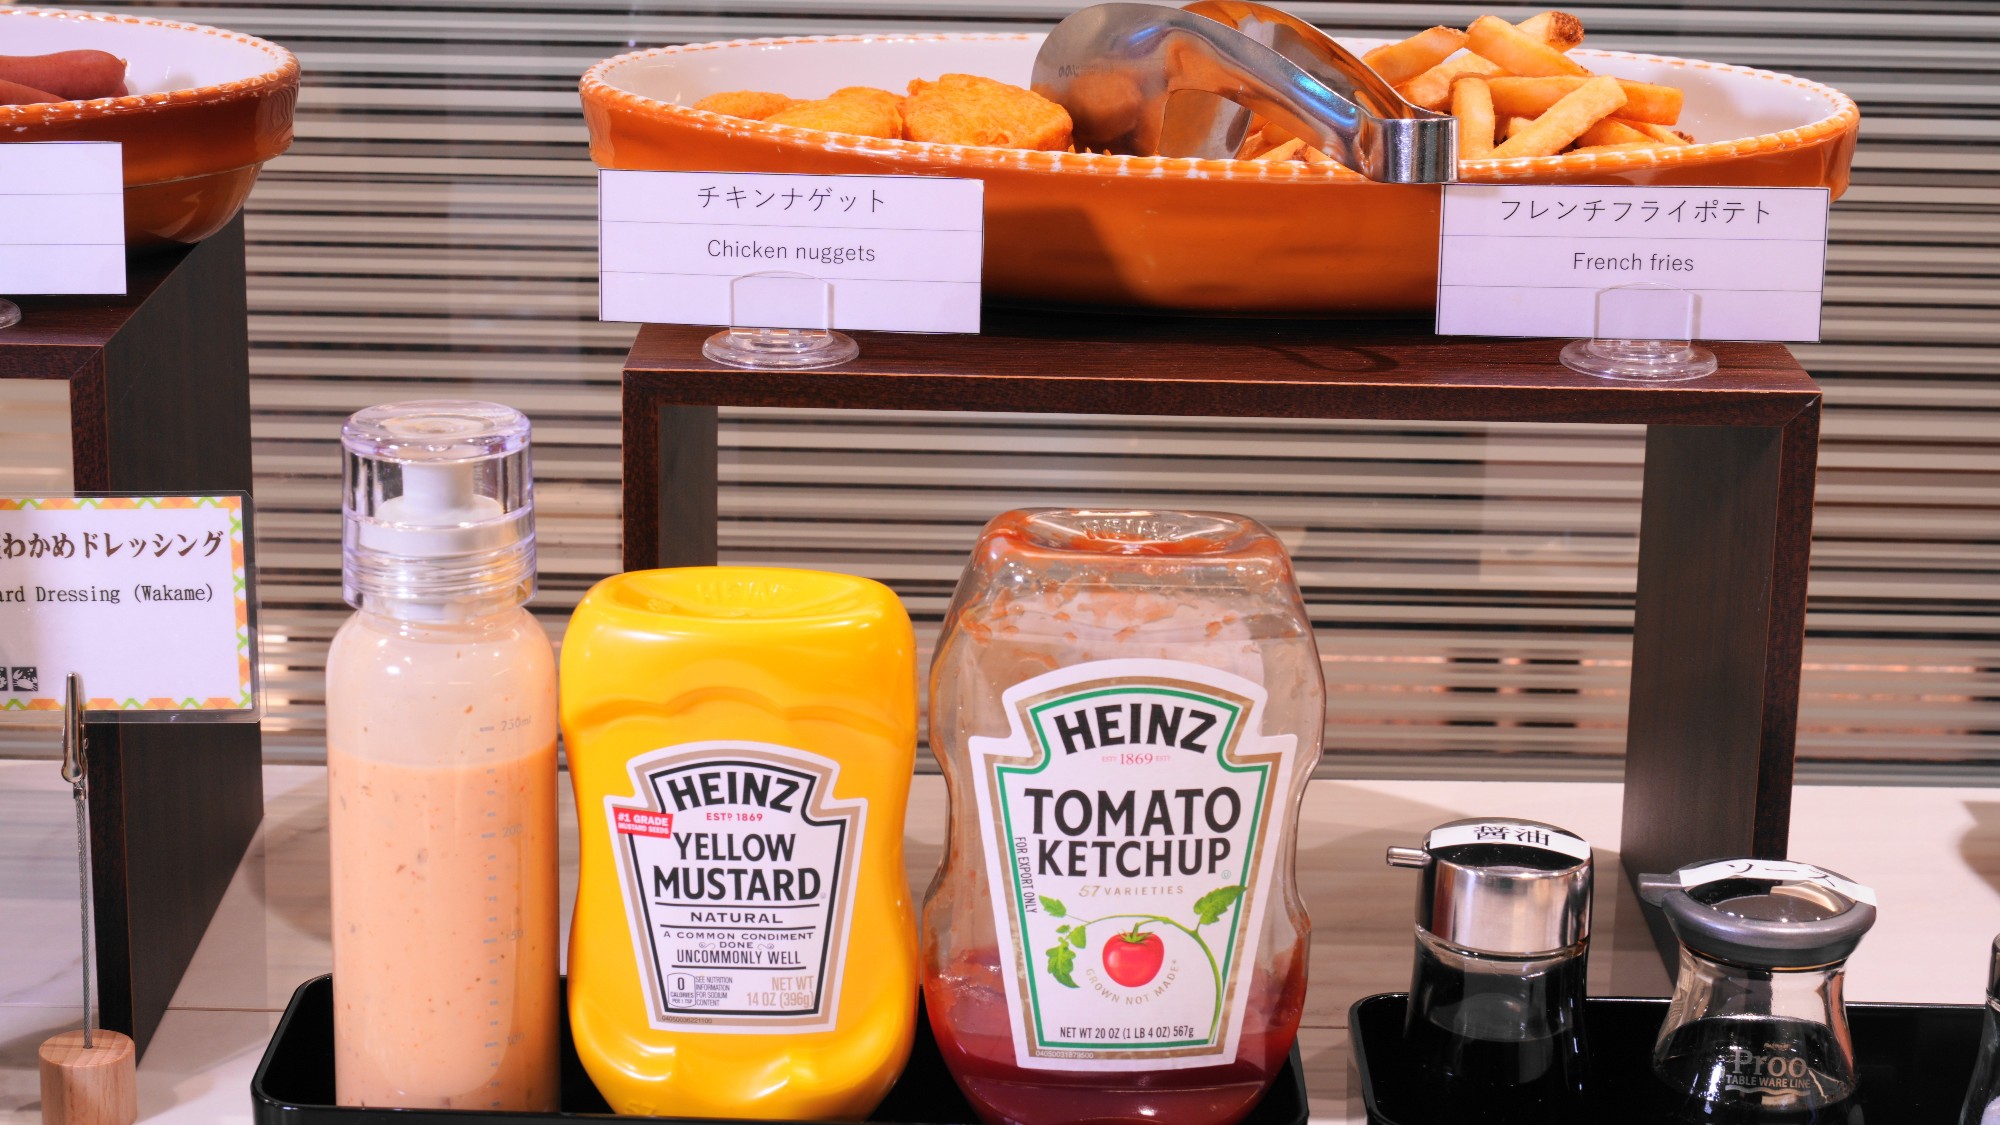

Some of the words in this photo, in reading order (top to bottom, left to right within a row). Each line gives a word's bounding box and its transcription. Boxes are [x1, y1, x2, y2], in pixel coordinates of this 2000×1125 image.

[697, 185, 884, 213] チキンナゲット
[1500, 198, 1771, 224] フレンチフライポテト
[707, 239, 788, 260] Chicken
[796, 245, 876, 265] nuggets
[1573, 252, 1642, 272] French
[1649, 253, 1694, 272] fries
[0, 530, 224, 559] わかめドレッシング
[36, 586, 121, 604] Dressing
[134, 584, 214, 603] (Wakame)
[1053, 702, 1218, 756] HEINZ
[1120, 753, 1153, 765] 1869
[666, 771, 800, 813] HEINZ
[618, 813, 631, 823] #1
[633, 815, 669, 827] GRADE
[736, 812, 763, 822] 1869
[1023, 786, 1242, 837] TOMATO
[618, 822, 648, 832] MUSTARD
[649, 825, 670, 834] SEEDS
[1474, 825, 1550, 847] 醤油
[673, 832, 797, 862] YELLOW
[1015, 836, 1029, 854] FOR
[1037, 837, 1232, 878] KETCHUP
[1018, 855, 1034, 889] EXPORT
[1726, 863, 1837, 888] ソース
[653, 865, 821, 902] MUSTARD
[1079, 885, 1101, 898] 57
[1104, 885, 1185, 897] VARIETIES
[1026, 890, 1038, 914] ONLY
[690, 911, 784, 924] NATURAL
[663, 931, 671, 939] A
[676, 931, 735, 940] COMMON
[741, 932, 814, 941] CONDIMENT
[719, 941, 754, 949] DONE
[676, 949, 762, 965] UNCOMMONLY
[767, 950, 801, 965] WELL
[677, 977, 685, 991] 0
[706, 976, 733, 984] NUTRITION
[771, 977, 793, 991] NET
[796, 975, 815, 990] WT
[1086, 968, 1120, 1003] GROWN
[1125, 994, 1151, 1005] NOT
[670, 991, 694, 999] CALORIES
[696, 991, 707, 999] FOR
[708, 991, 728, 999] SODIUM
[696, 999, 720, 1007] CONTENT
[746, 992, 759, 1006] 14
[762, 992, 777, 1006] OZ
[779, 991, 815, 1009] (396g)
[1059, 1026, 1076, 1039] NET
[1079, 1027, 1093, 1039] WT
[1094, 1027, 1106, 1039] 20
[1108, 1027, 1120, 1039] OZ
[1122, 1027, 1132, 1039] (1
[1134, 1027, 1146, 1039] LB
[1147, 1027, 1154, 1038] 4
[1156, 1026, 1171, 1039] OZ)
[1173, 1025, 1195, 1038] 567g
[1731, 1048, 1808, 1079] Proo
[1725, 1074, 1757, 1086] TABLE
[1759, 1077, 1788, 1088] WARE
[1789, 1079, 1811, 1089] LINE
